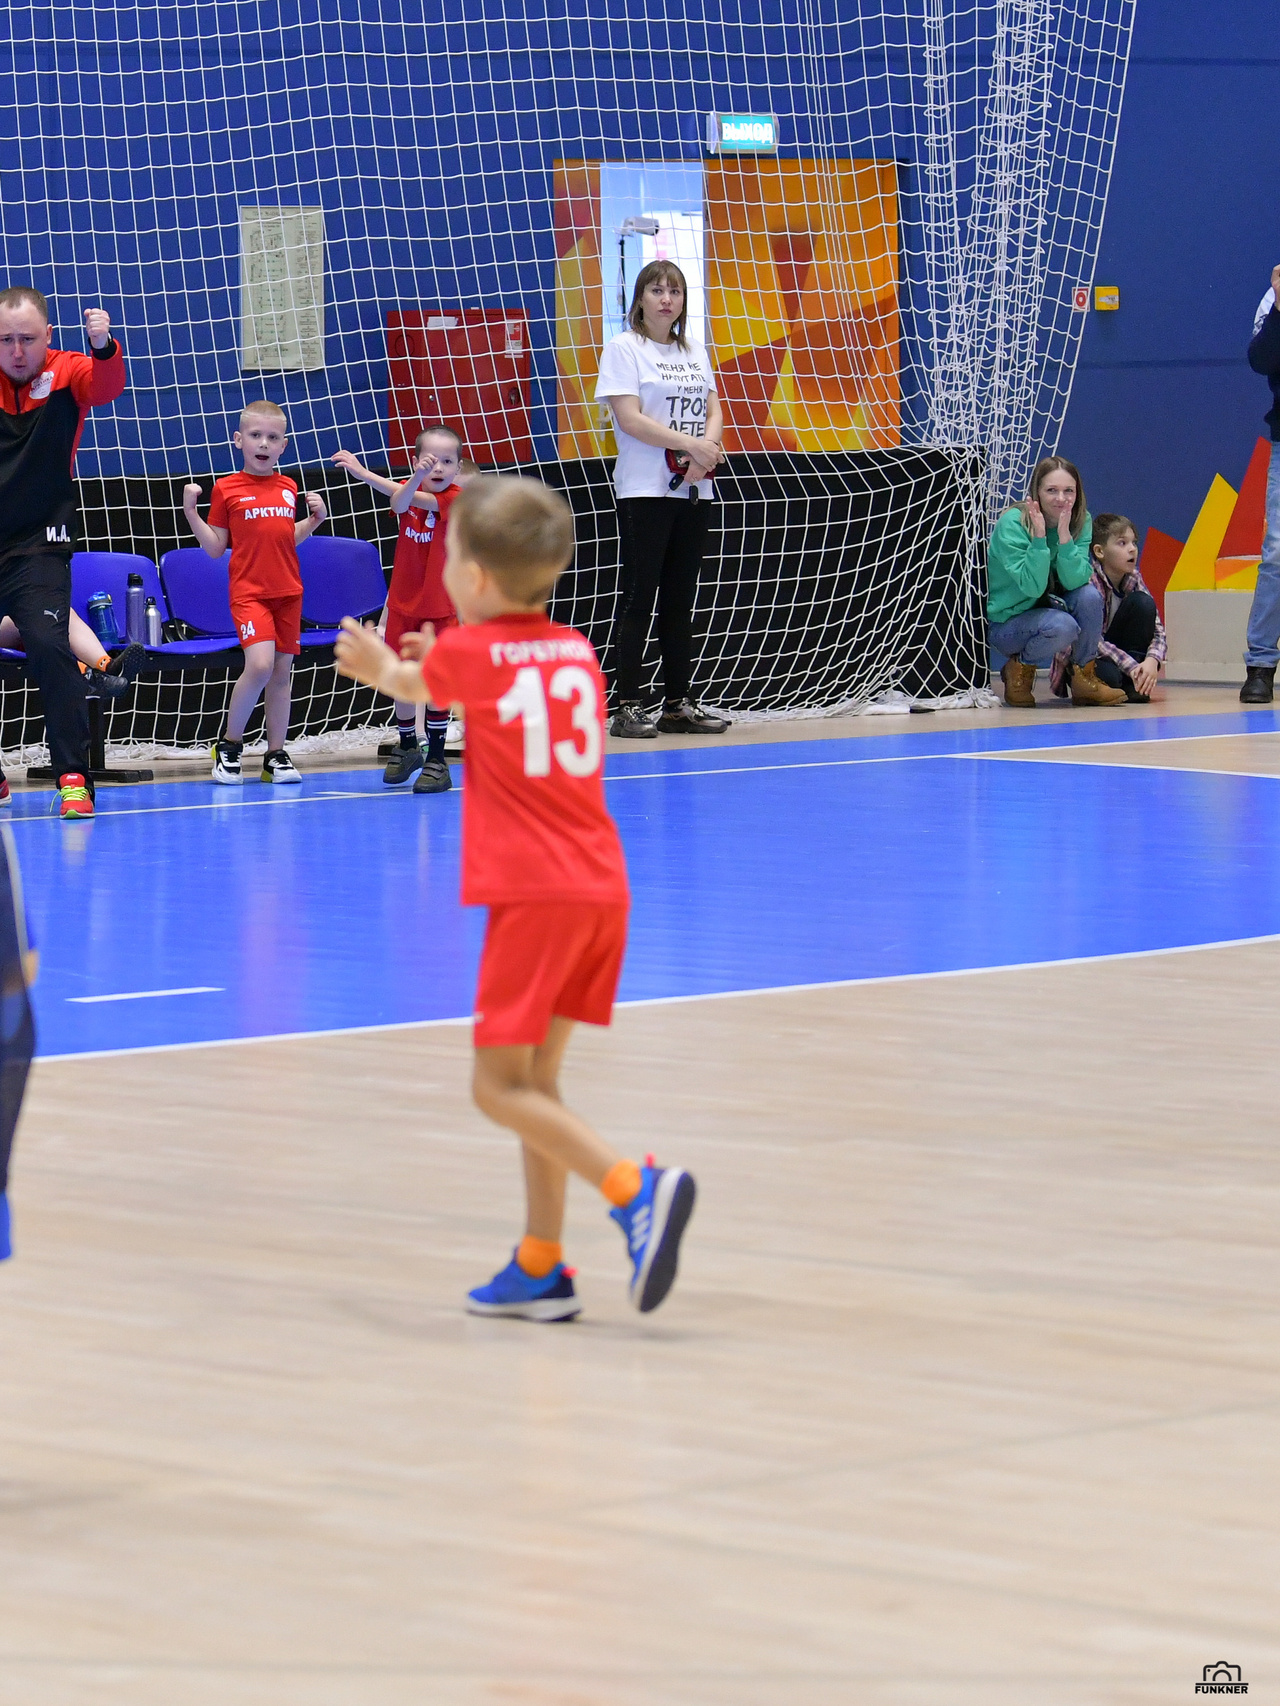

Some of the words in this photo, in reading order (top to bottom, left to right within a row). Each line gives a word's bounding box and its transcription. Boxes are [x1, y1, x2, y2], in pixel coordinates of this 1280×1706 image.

[722, 122, 773, 144] ВЫХОД
[656, 362, 685, 372] МЕНЯ
[683, 385, 703, 394] МЕНЯ
[244, 506, 295, 521] АРКТИКА
[240, 620, 256, 640] 24
[496, 665, 601, 778] 13
